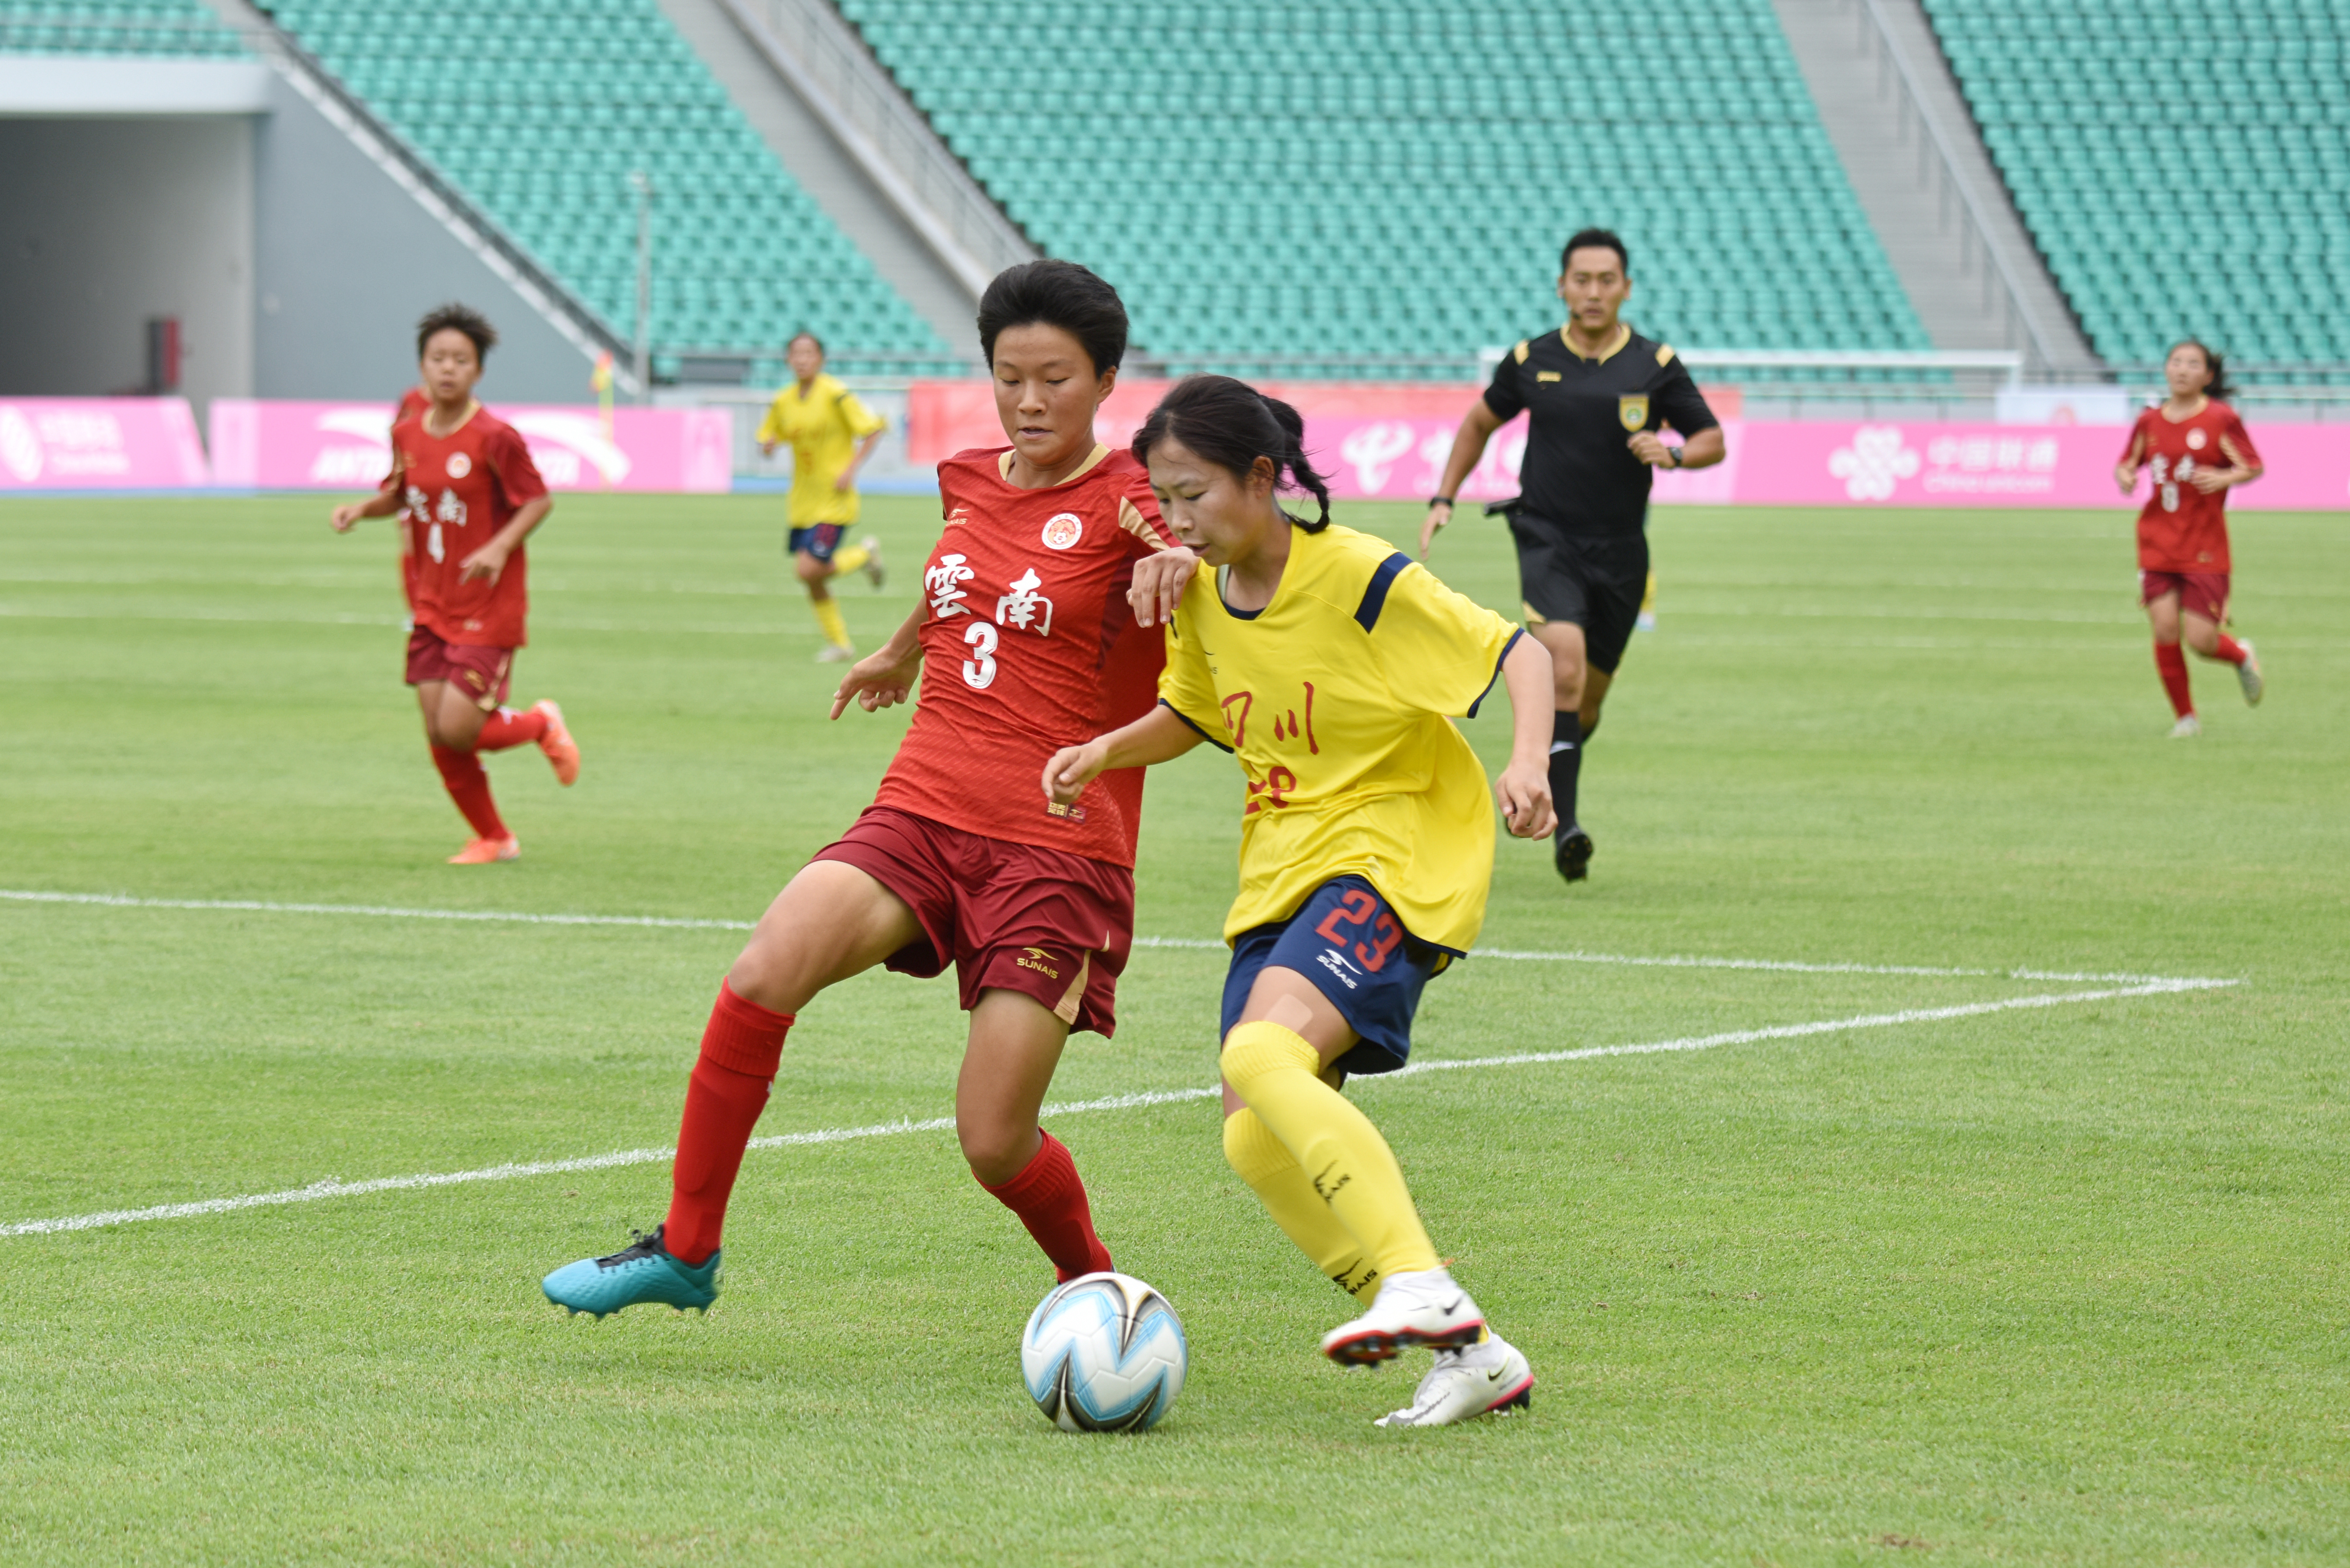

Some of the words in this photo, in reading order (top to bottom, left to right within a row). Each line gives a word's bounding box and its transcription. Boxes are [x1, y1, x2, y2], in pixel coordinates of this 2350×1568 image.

[924, 553, 1052, 636] 雲南
[963, 622, 998, 689] 3
[1315, 889, 1403, 972] 23
[1017, 958, 1059, 979] SUNAIS
[1316, 955, 1358, 989] SUNAIS
[1348, 1269, 1378, 1295] NAIS
